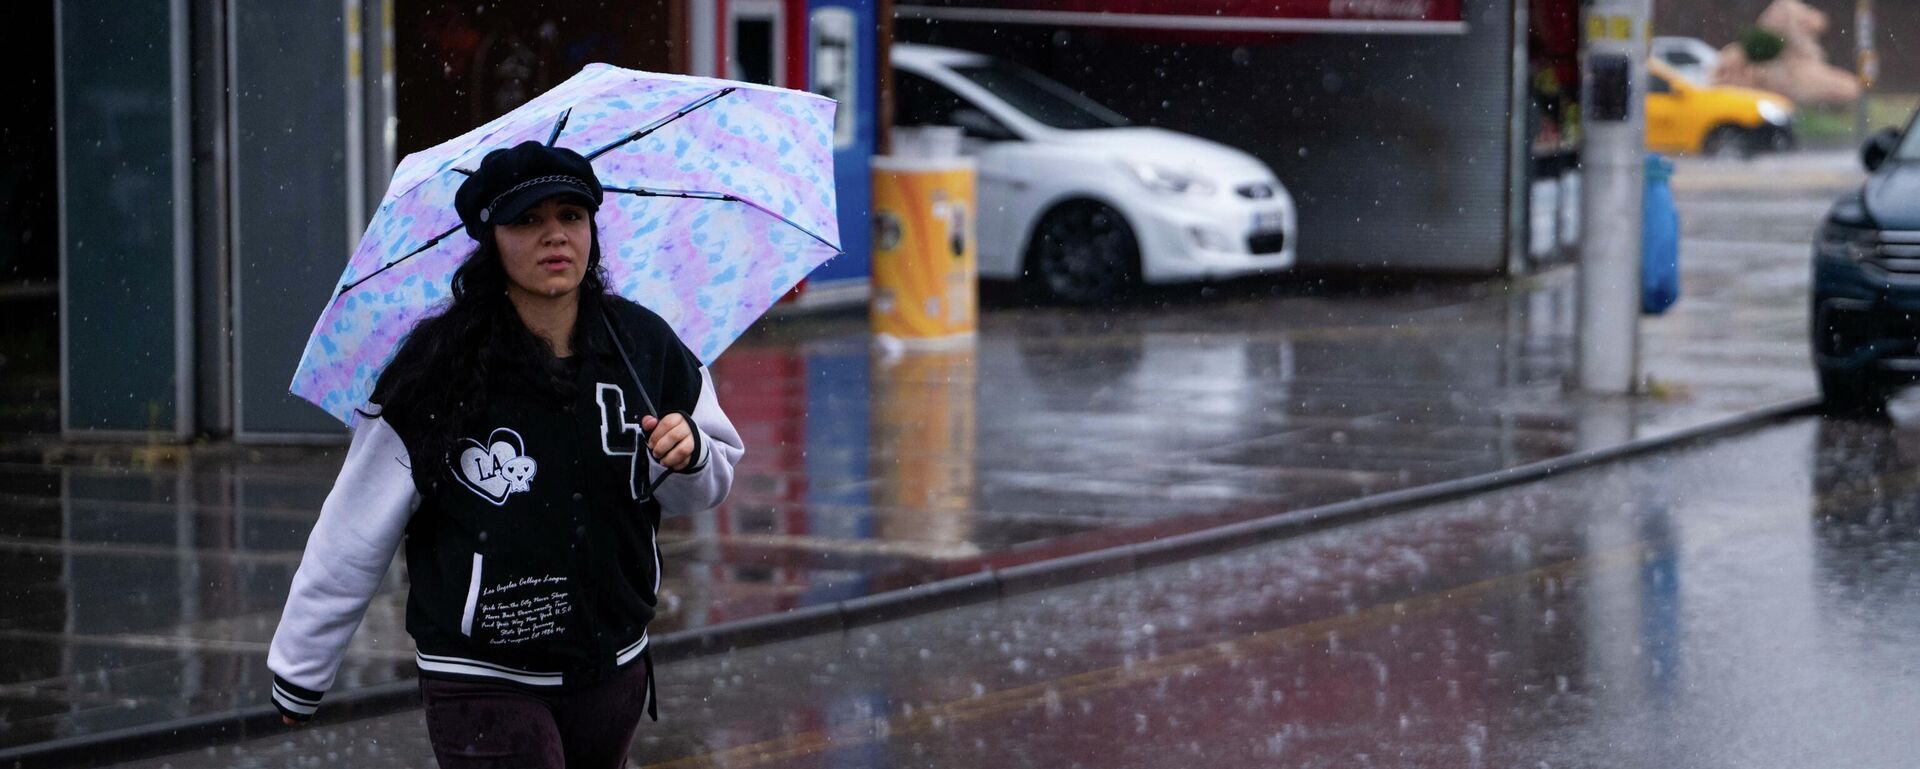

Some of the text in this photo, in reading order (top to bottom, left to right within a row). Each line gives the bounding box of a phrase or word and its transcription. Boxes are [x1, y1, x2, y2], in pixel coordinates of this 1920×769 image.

[483, 574, 568, 596] Los Angeles College League
